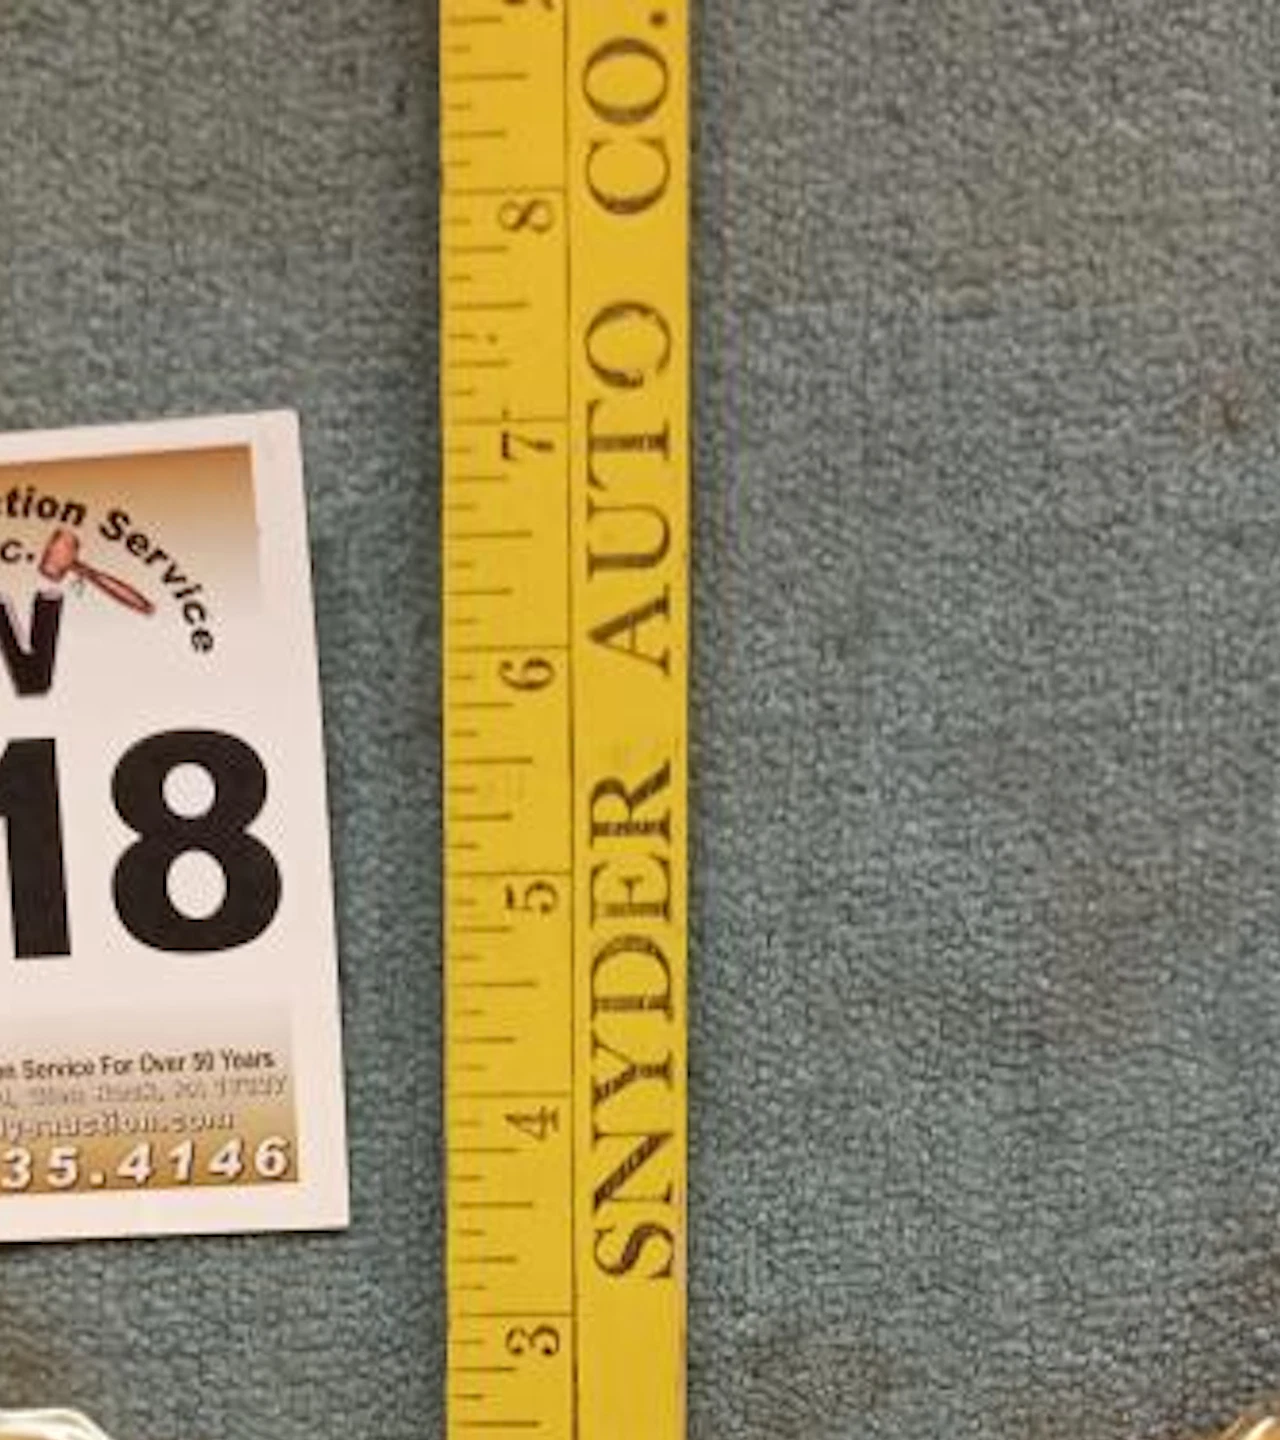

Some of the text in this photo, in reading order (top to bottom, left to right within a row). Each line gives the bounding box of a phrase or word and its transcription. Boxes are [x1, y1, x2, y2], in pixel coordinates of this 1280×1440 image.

[497, 198, 554, 234] 8
[500, 408, 556, 462] 7
[98, 508, 215, 654] Service
[581, 10, 674, 1281] SNYDER AUTO CO.
[498, 655, 556, 693] 6
[504, 879, 560, 915] 5
[22, 1058, 96, 1080] Service
[101, 1055, 134, 1076] For
[140, 1051, 185, 1074] Over
[220, 1048, 275, 1070] Years
[504, 1104, 560, 1141] 4
[504, 1323, 561, 1357] 3
